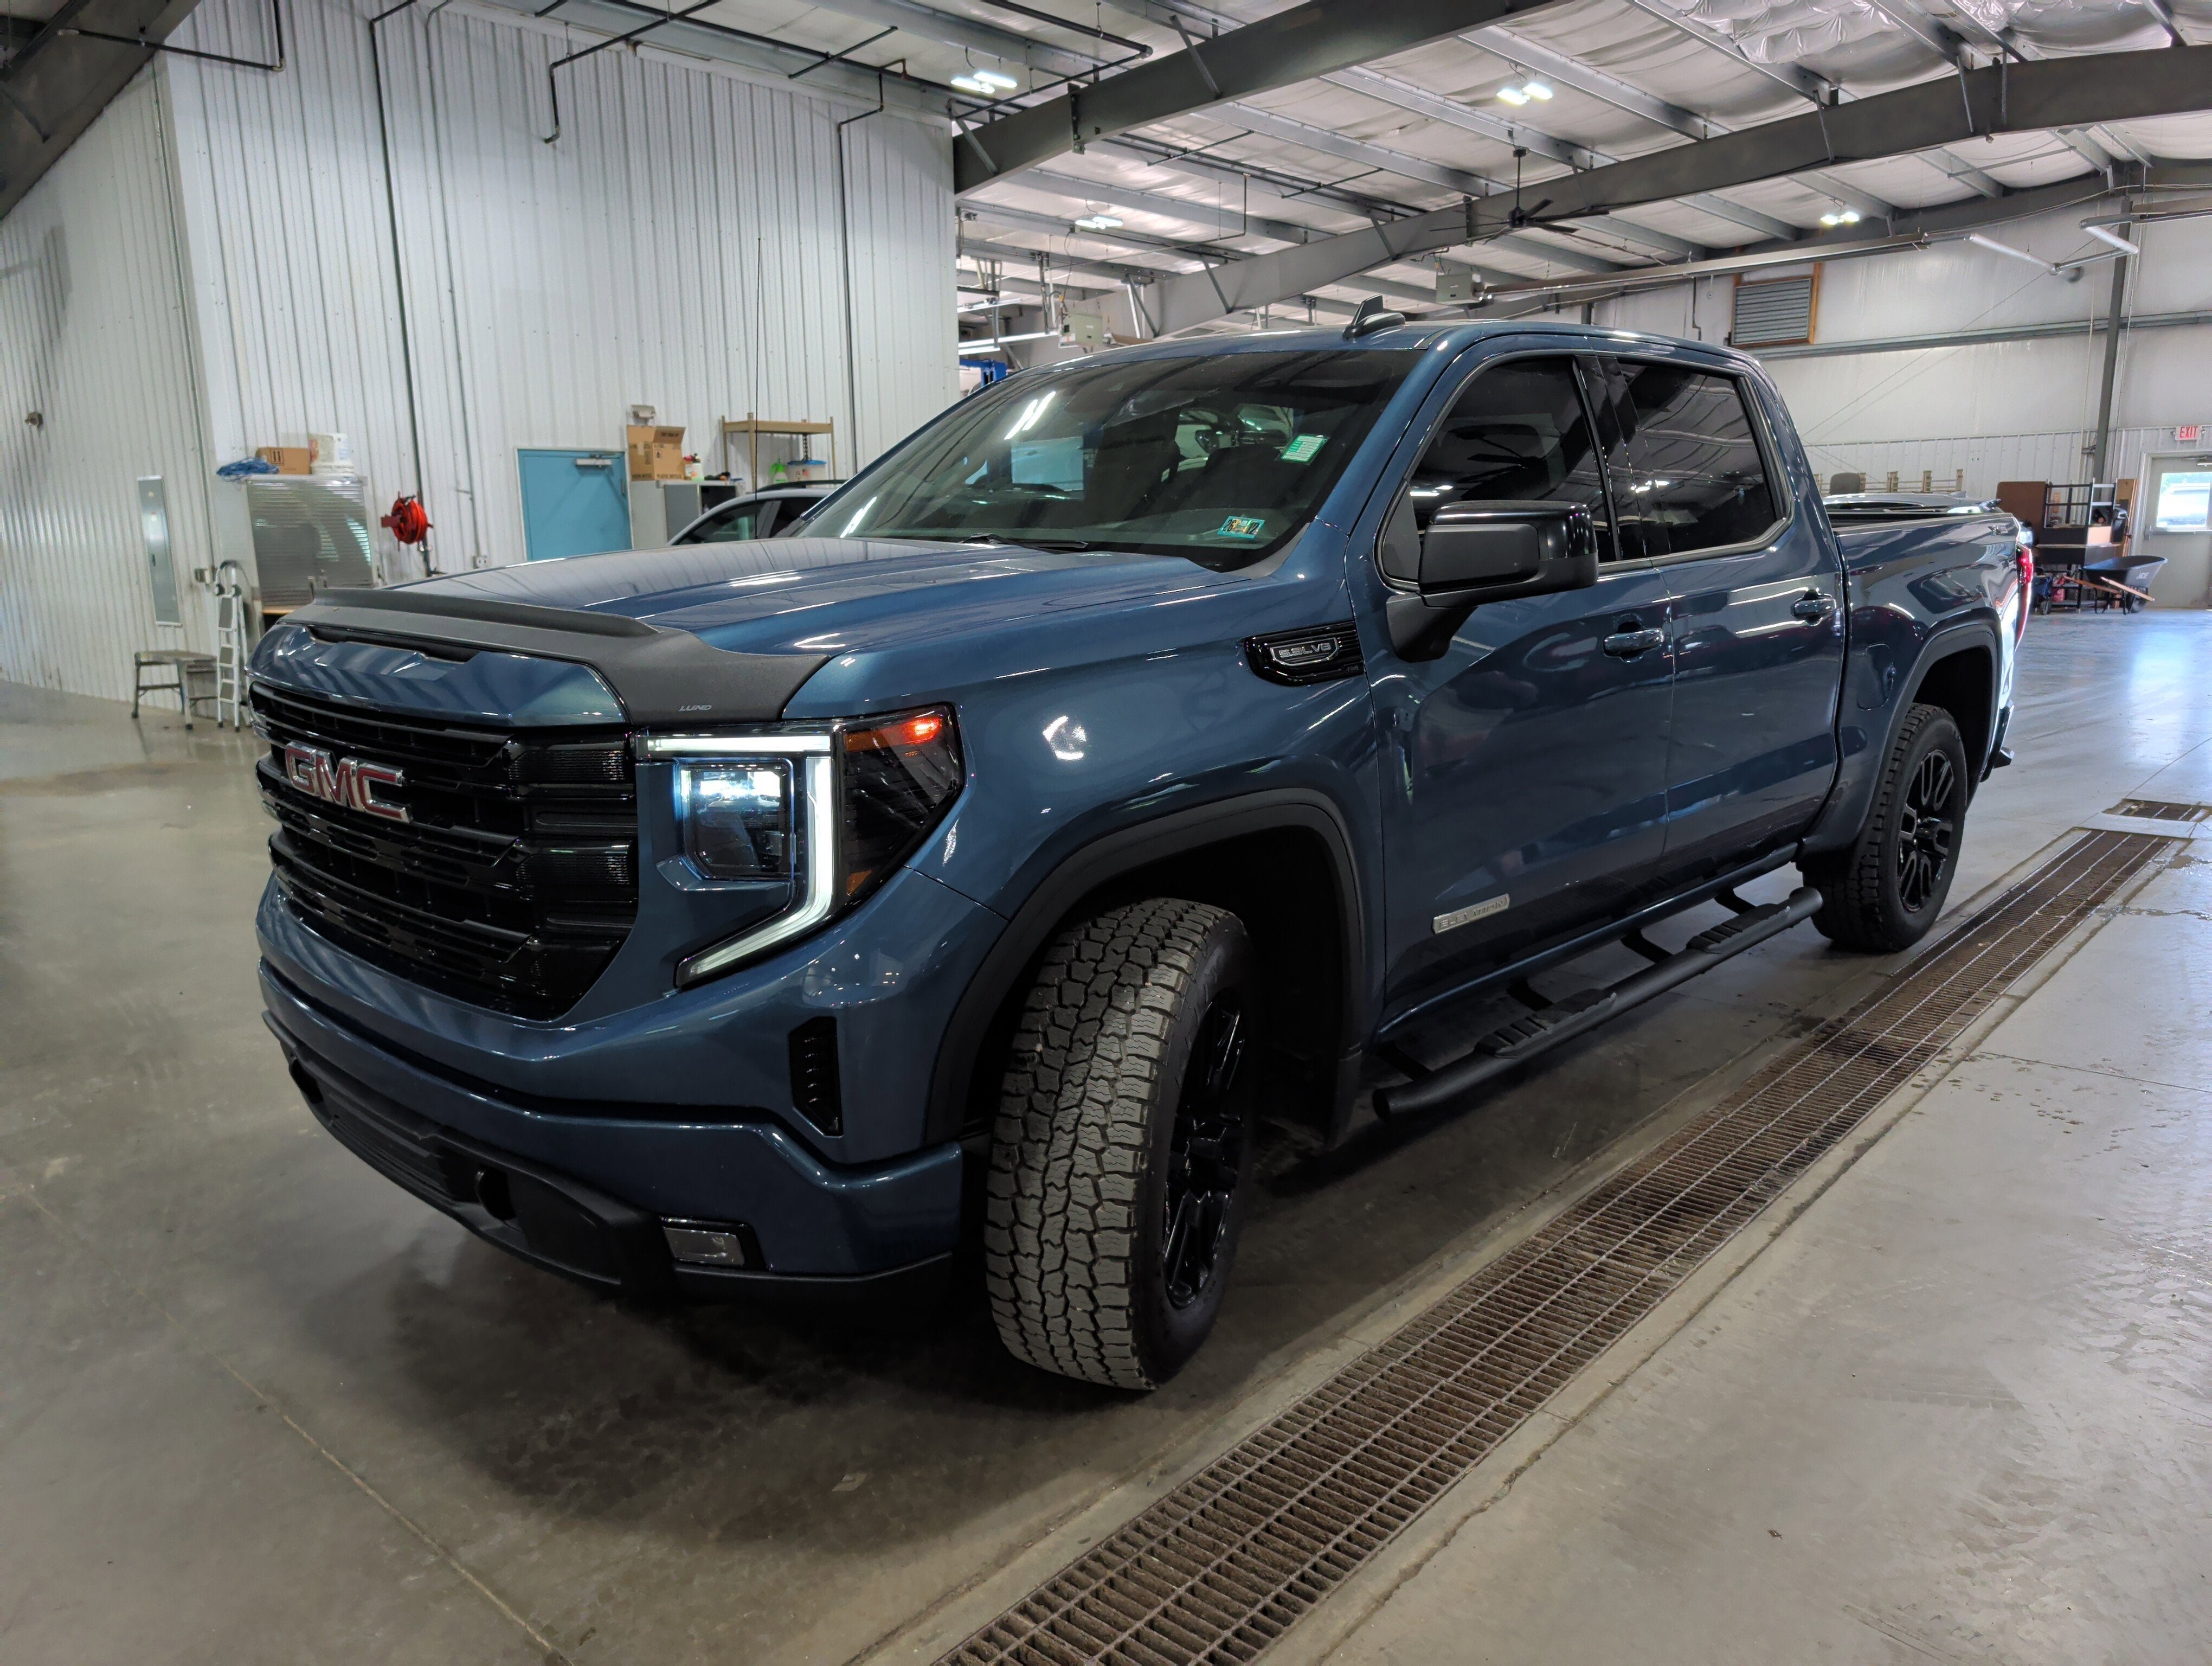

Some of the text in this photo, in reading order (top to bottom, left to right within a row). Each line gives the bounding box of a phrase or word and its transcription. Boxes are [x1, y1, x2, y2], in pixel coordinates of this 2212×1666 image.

[2179, 426, 2198, 438] EXIT
[1223, 520, 1260, 535] 26 12
[285, 741, 411, 823] GMC
